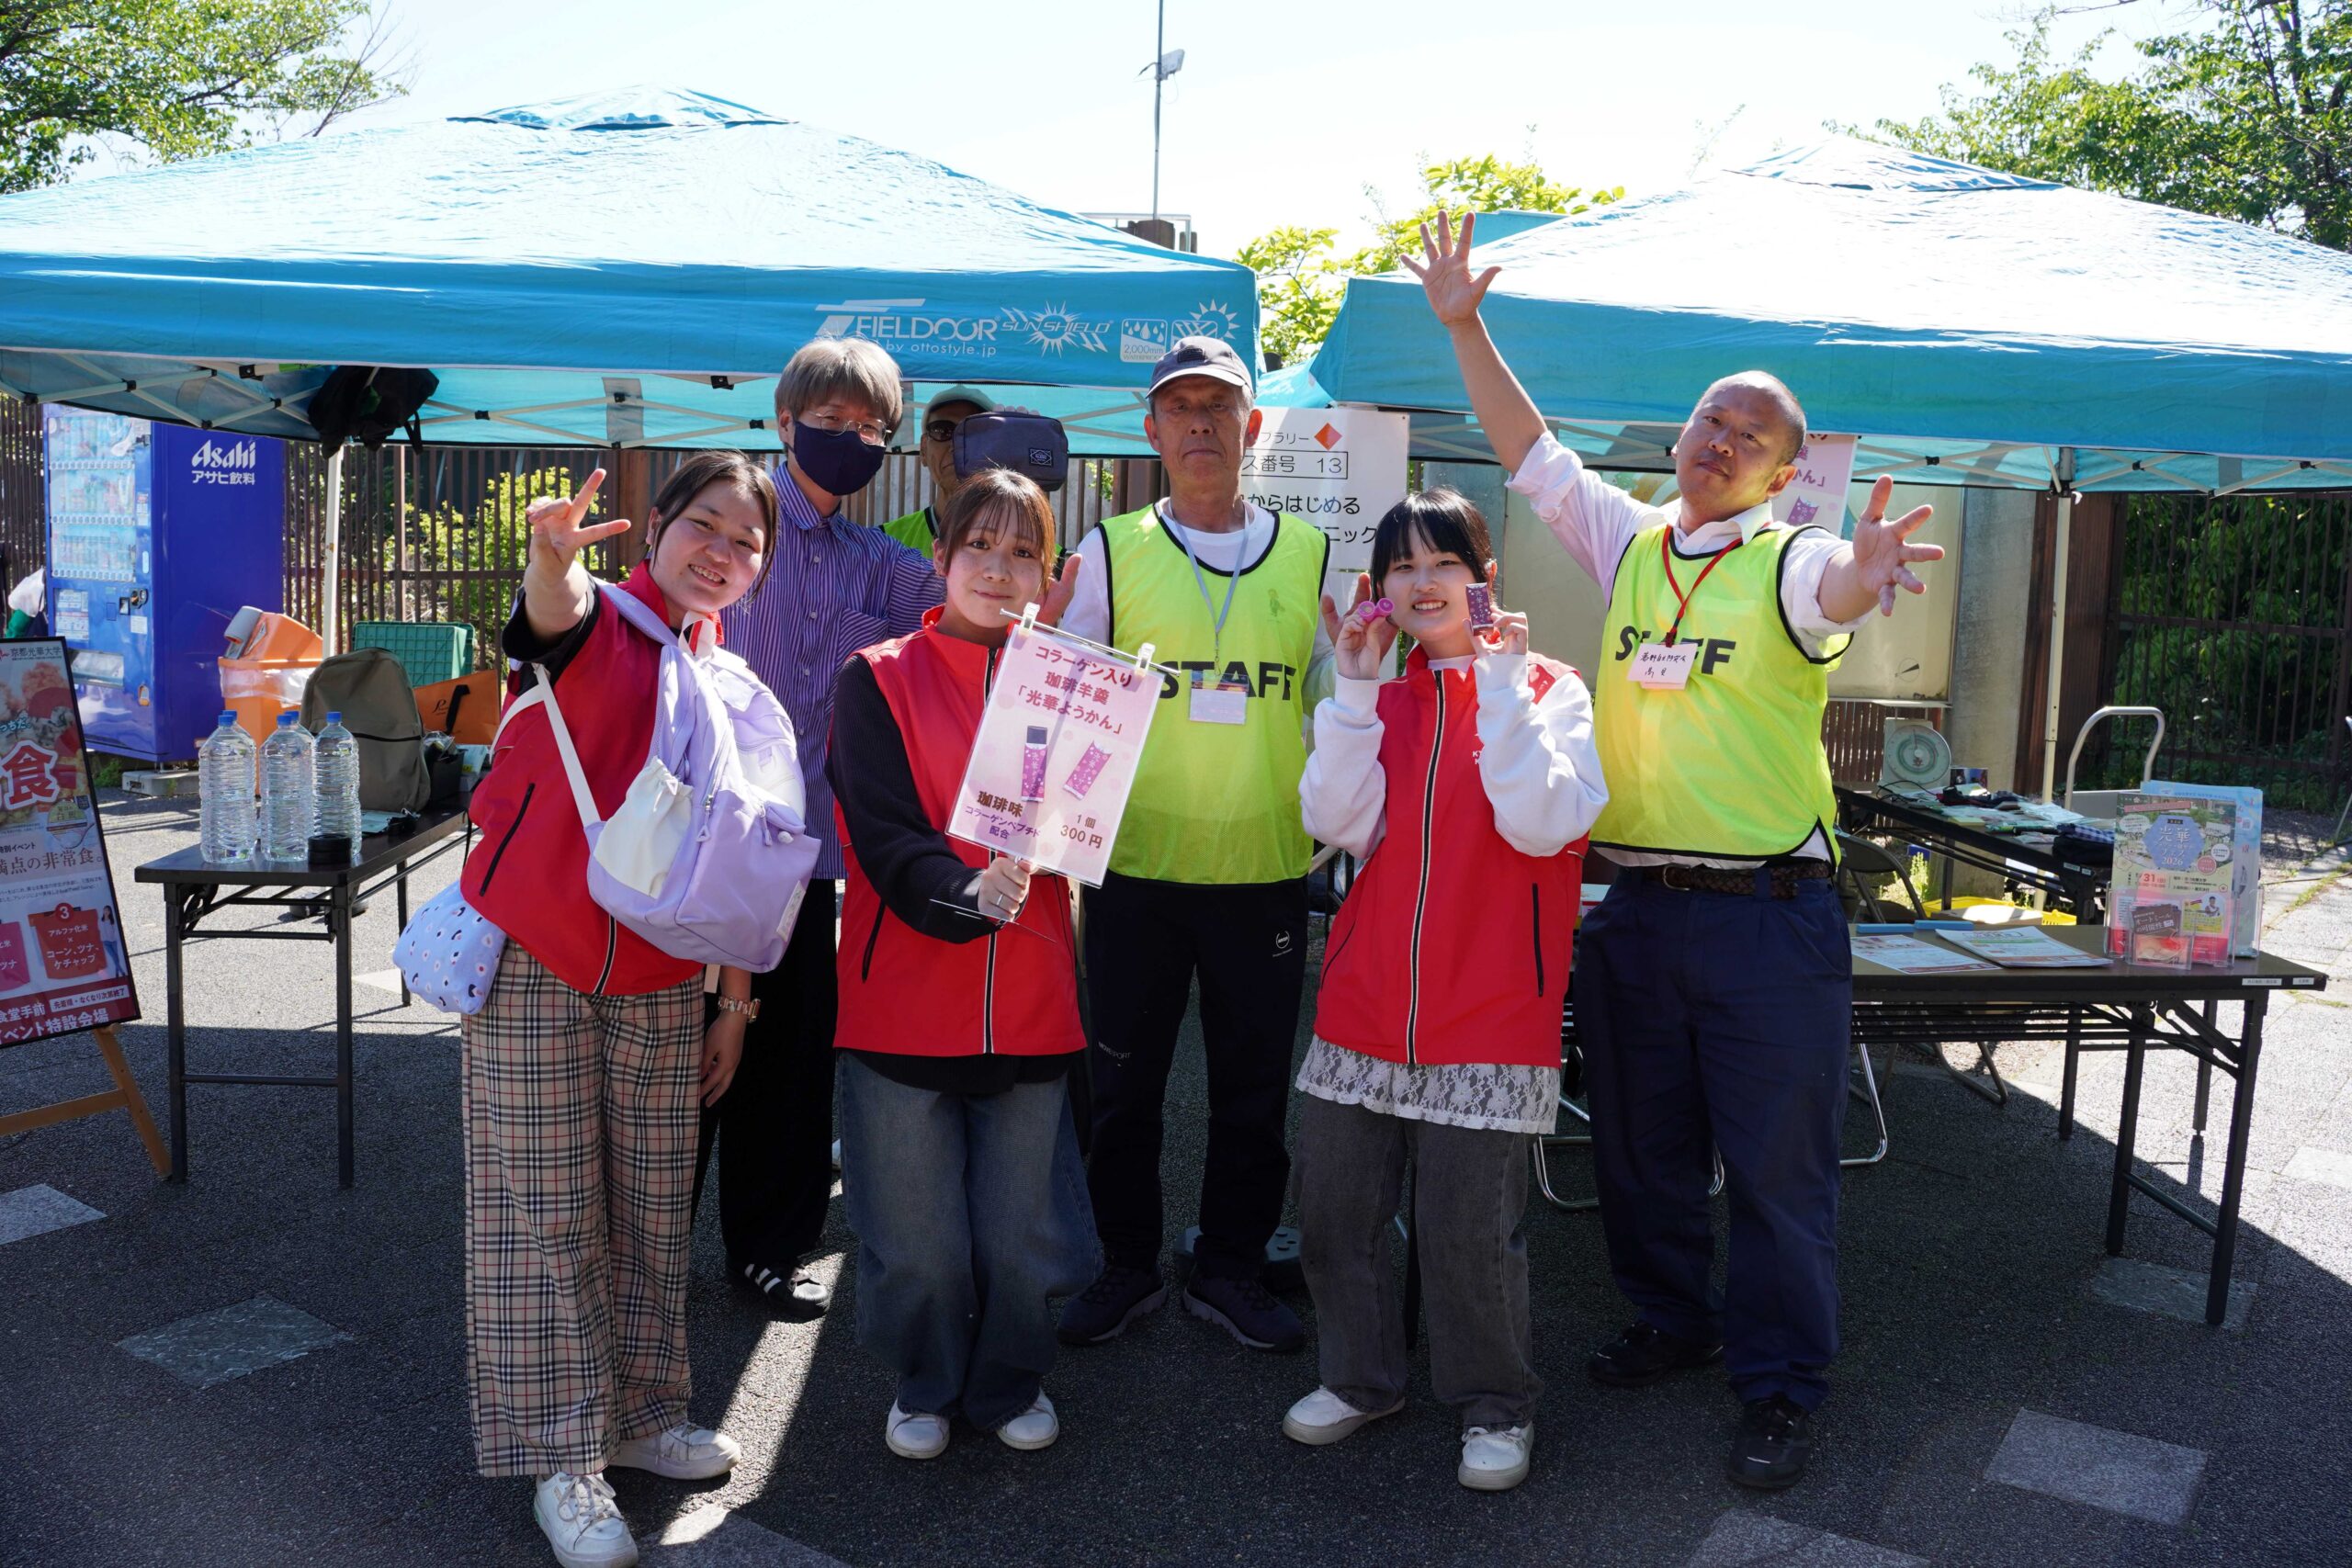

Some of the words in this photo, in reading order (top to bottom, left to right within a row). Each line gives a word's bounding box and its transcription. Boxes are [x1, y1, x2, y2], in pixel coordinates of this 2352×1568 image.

[856, 315, 997, 342] FIELDOOR
[1001, 321, 1042, 332] SUN
[1043, 321, 1110, 333] SHIELD
[886, 339, 905, 353] by
[910, 341, 997, 358] ottostyle.jp
[1124, 344, 1164, 355] 2,000mm
[191, 440, 256, 469] Asahi
[191, 470, 255, 485] アサヒ飲料
[1240, 493, 1361, 515] からはじめる
[1313, 525, 1377, 544] ニック
[9, 646, 62, 659] 京都光華大学
[1035, 646, 1133, 687] コラーゲン入り
[1044, 671, 1110, 705] 珈琲羊羹
[1018, 684, 1123, 735] 「光華ようかん」
[1, 744, 57, 807] 食
[977, 790, 1023, 818] 珈琲味
[989, 825, 1011, 840] 配合
[60, 906, 70, 919] 3
[0, 1008, 109, 1044] ベント特設会場
